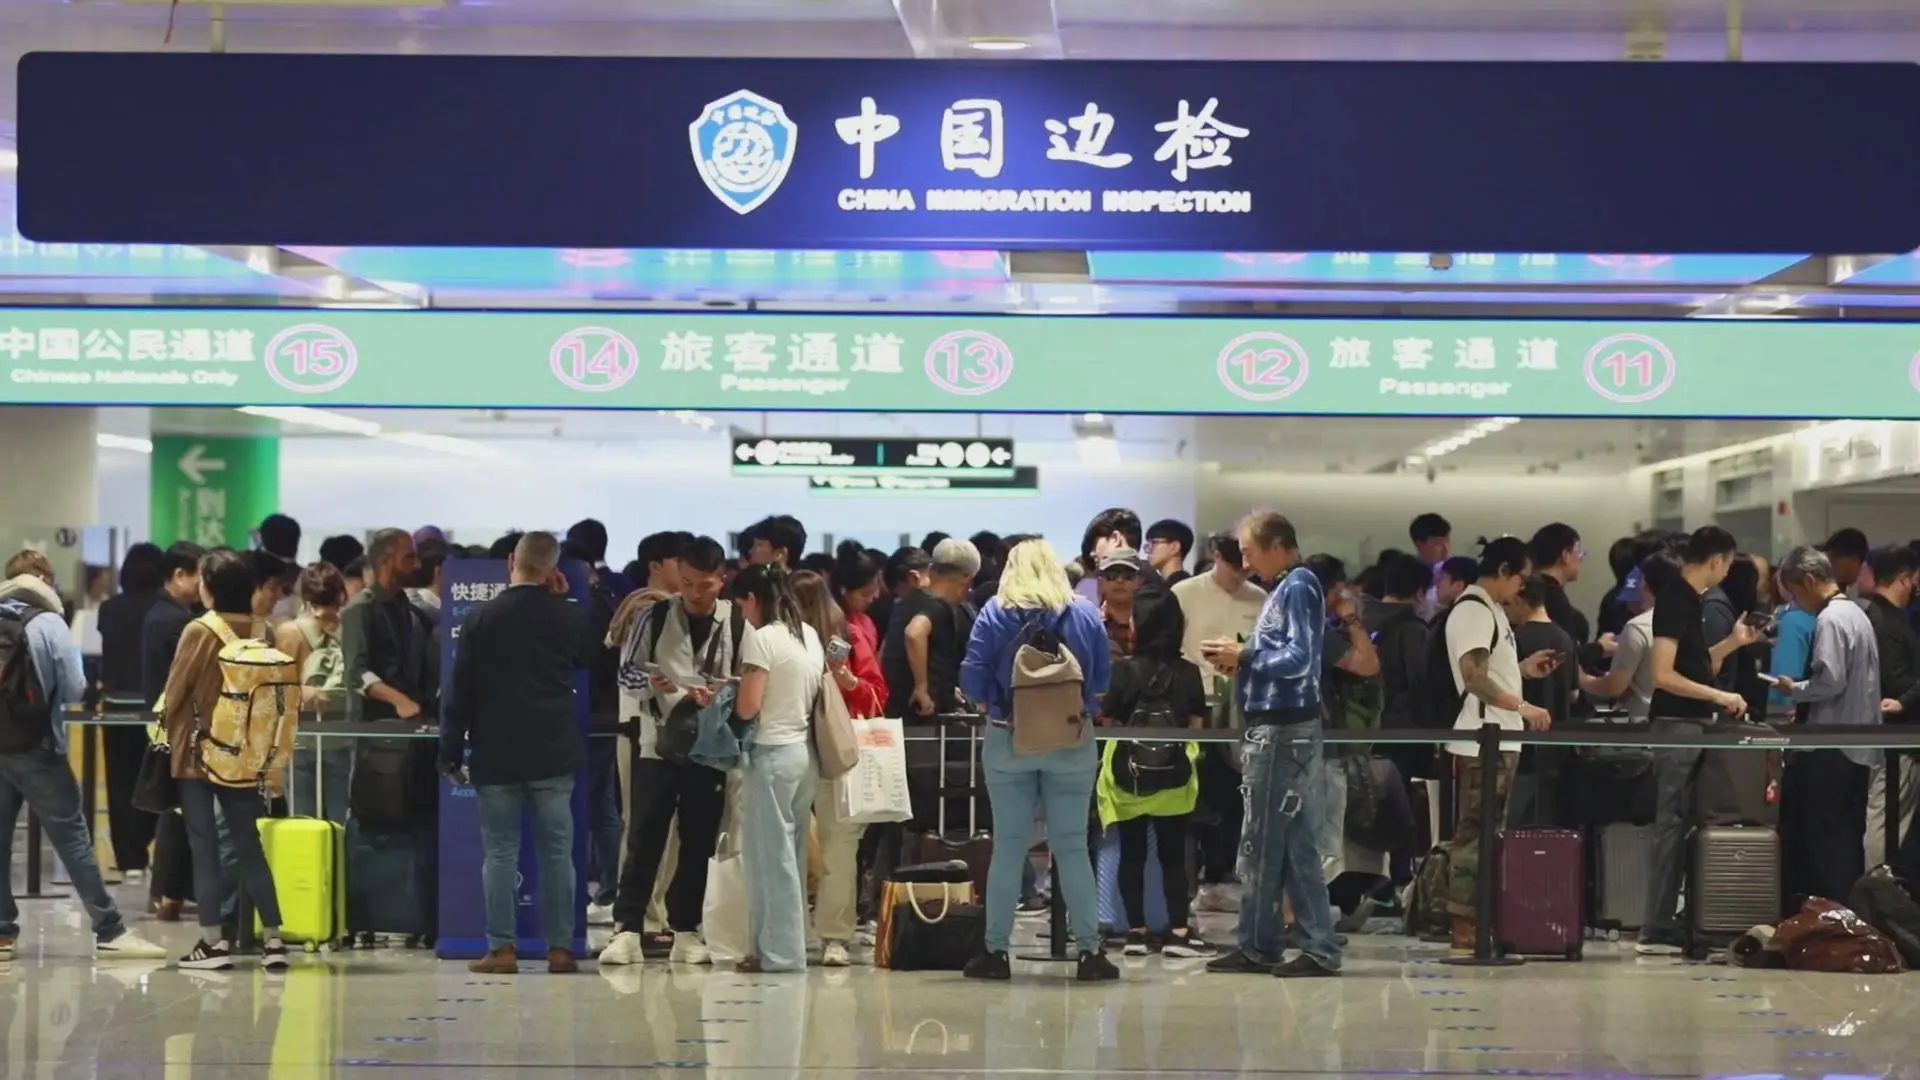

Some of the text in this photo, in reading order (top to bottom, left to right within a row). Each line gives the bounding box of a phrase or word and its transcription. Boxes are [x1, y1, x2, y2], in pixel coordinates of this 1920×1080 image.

[835, 97, 1250, 182] 中国边检
[838, 189, 1252, 212] CHINA IMMIGRATION INSPECTION
[0, 327, 255, 361] 中国公民通道
[281, 339, 342, 375] 15
[563, 338, 622, 379] 14
[661, 331, 904, 373] 旅客通道
[1329, 336, 1559, 370] 旅客通道
[10, 369, 238, 387] Chinese Nationals Only
[940, 342, 1000, 383] 13
[1231, 349, 1292, 384] 12
[1601, 353, 1657, 388] 11
[720, 374, 849, 394] Passenger
[1379, 379, 1511, 399] Passenger
